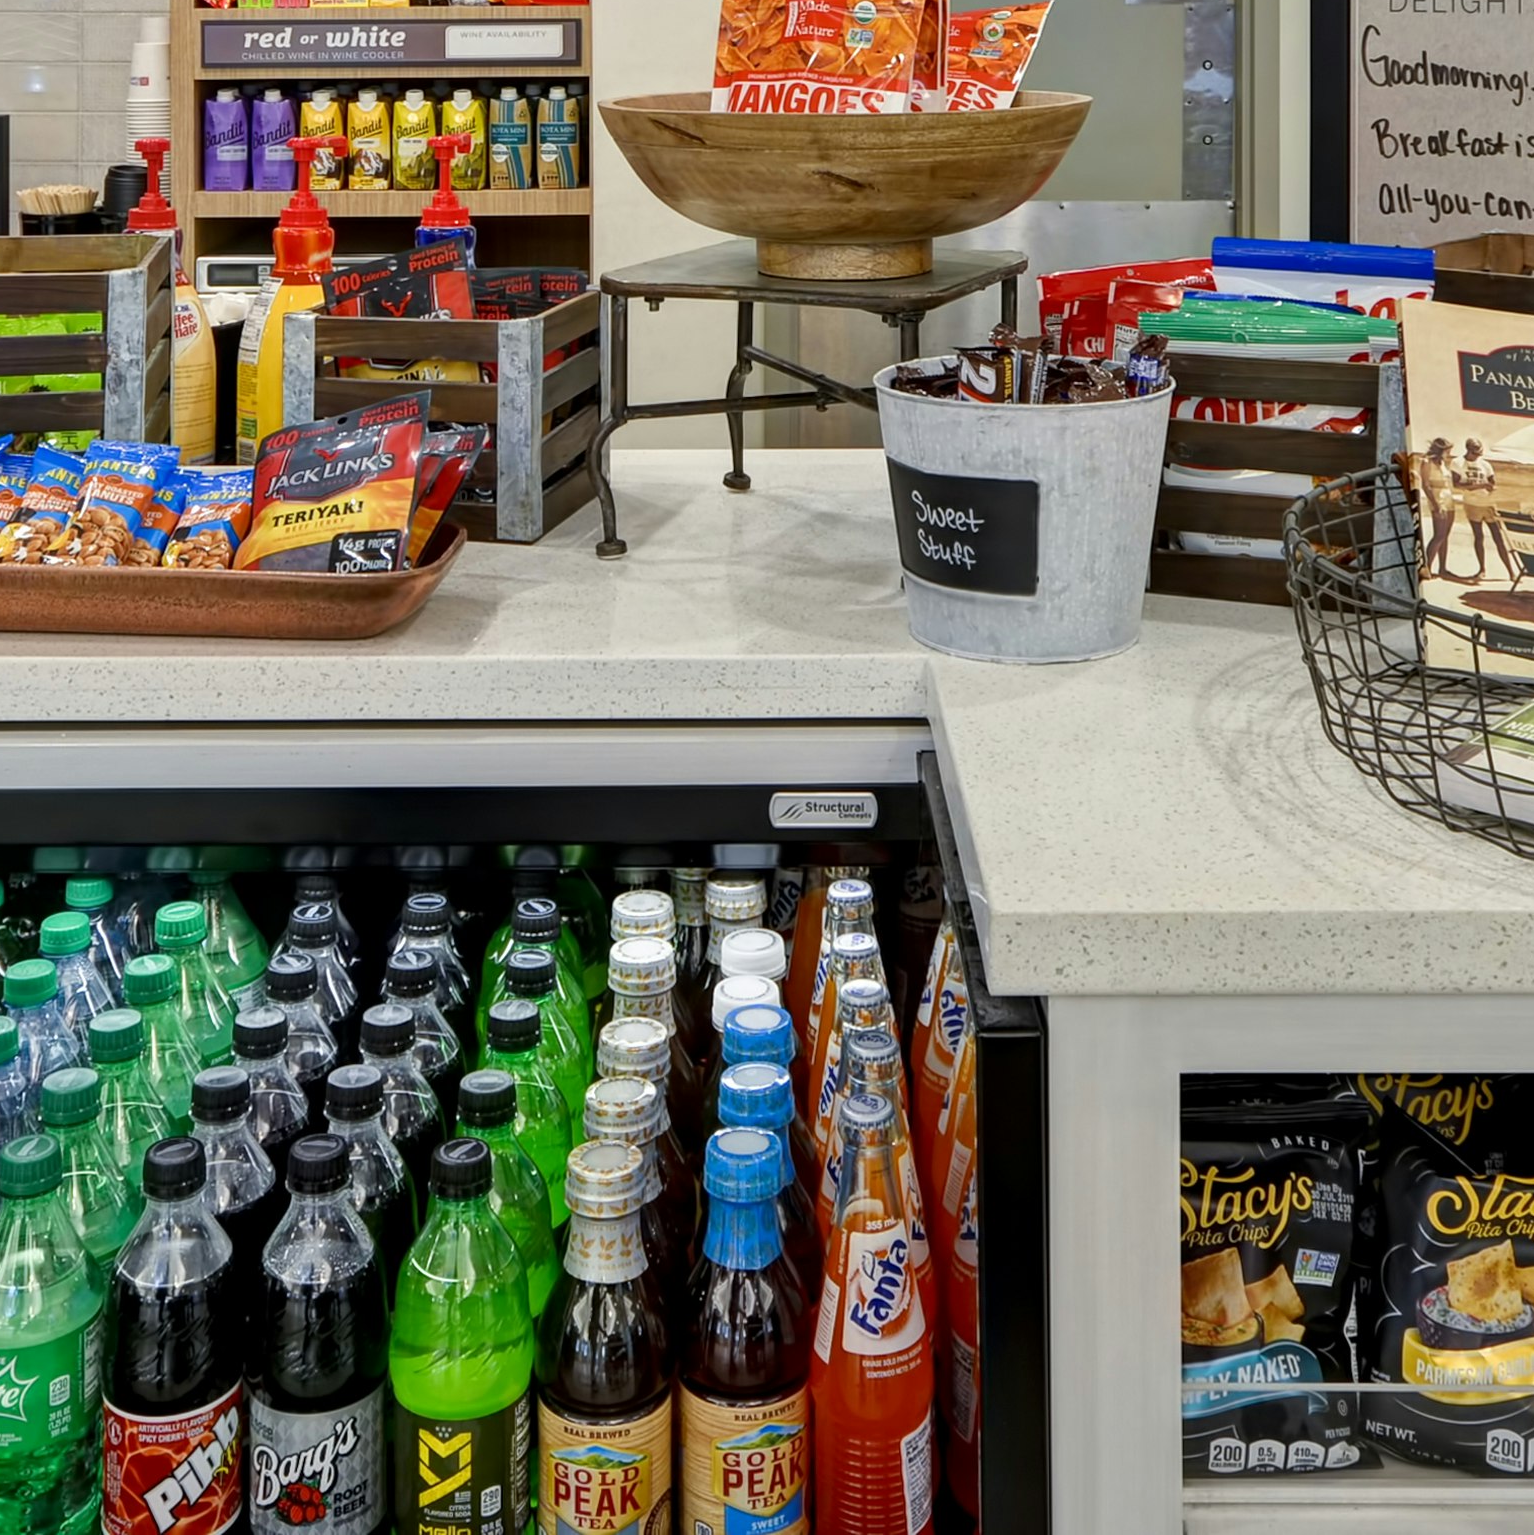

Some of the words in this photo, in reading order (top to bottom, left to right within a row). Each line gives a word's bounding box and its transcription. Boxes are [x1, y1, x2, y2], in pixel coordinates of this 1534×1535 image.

[799, 0, 830, 13] Made
[244, 27, 292, 48] red
[300, 34, 318, 45] or
[326, 26, 406, 48] white
[460, 31, 483, 39] WINE
[486, 30, 547, 38] AVAILABILITY
[794, 24, 837, 37] Nature
[241, 51, 285, 60] CHILLED
[288, 51, 315, 60] WINE
[318, 51, 329, 59] IN
[331, 51, 358, 59] WINE
[362, 51, 404, 59] COOLER
[350, 117, 383, 140] Bandit
[396, 117, 429, 138] Bandit
[1371, 117, 1509, 160] Breakfast
[409, 250, 458, 272] Protein
[331, 272, 360, 296] 100
[363, 269, 391, 283] Calories
[359, 403, 419, 426] Protein
[266, 430, 300, 451] 100
[265, 466, 321, 497] JACK
[323, 453, 393, 475] LINK'S
[912, 490, 985, 533] Sweet
[918, 529, 978, 572] Stuff
[805, 801, 865, 813] Structural
[838, 812, 872, 820] Concepts
[1271, 1135, 1330, 1152] BAKED
[1186, 1230, 1225, 1248] Pita
[1228, 1223, 1270, 1248] Chips
[1467, 1221, 1504, 1240] Pita
[850, 1239, 908, 1337] Fanta
[1237, 1352, 1301, 1385] NAKED
[138, 1421, 181, 1434] ARTIFICIALLY
[181, 1411, 215, 1430] FLAVORED
[734, 1412, 758, 1422] REAL
[138, 1433, 157, 1444] SPICY
[564, 1425, 586, 1439] REAL
[589, 1428, 631, 1440] BREWED
[1366, 1419, 1392, 1437] NET
[1394, 1426, 1417, 1444] WT.
[722, 1435, 805, 1468] GOLD
[1213, 1445, 1242, 1462] 200
[1490, 1437, 1522, 1459] 200
[143, 1406, 240, 1534] Pibb
[254, 1416, 358, 1507] Barq's
[554, 1461, 641, 1486] GOLD
[722, 1451, 805, 1499] PEAK
[333, 1479, 369, 1505] ROOT
[483, 1487, 500, 1504] 290
[554, 1476, 643, 1518] PEAK
[748, 1491, 787, 1511] TEA
[334, 1496, 368, 1519] BEER
[424, 1508, 453, 1517] FLAVORED
[449, 1503, 471, 1513] CITRUS
[574, 1515, 617, 1529] TEA
[751, 1515, 786, 1531] SWEET
